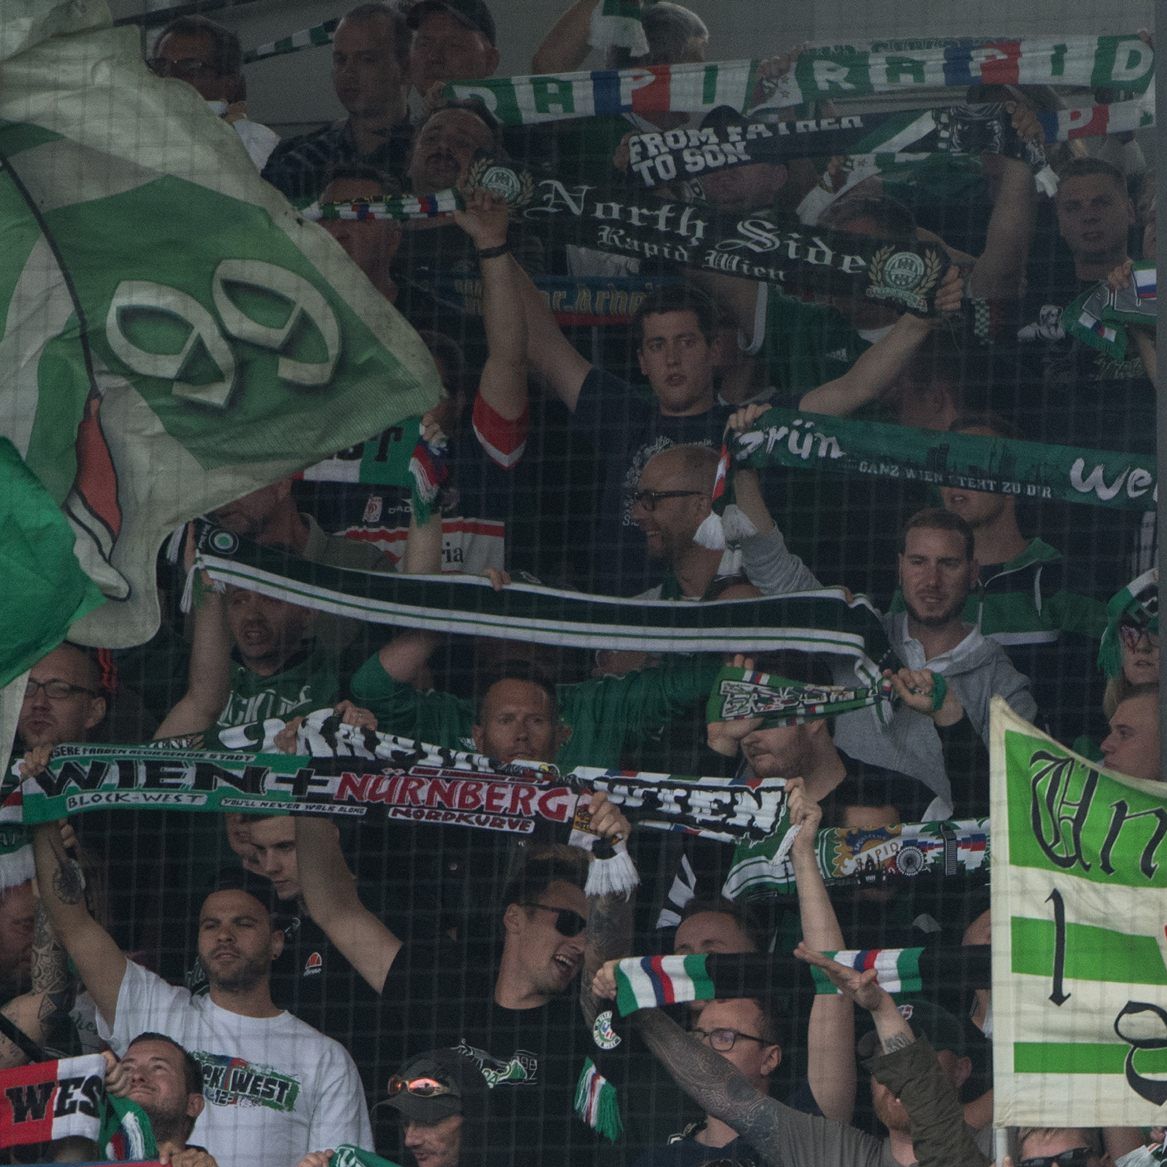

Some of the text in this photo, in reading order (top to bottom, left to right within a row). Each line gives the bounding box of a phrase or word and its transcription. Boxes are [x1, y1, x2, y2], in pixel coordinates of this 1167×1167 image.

[812, 40, 1152, 91] RAPID
[629, 126, 719, 163] FROM
[631, 142, 751, 188] TO SON
[524, 180, 867, 274] North Side
[597, 225, 787, 283] Rapid Wien
[34, 759, 270, 799] WIEN
[334, 768, 572, 823] NÜRNBERG
[67, 792, 204, 810] BLOCK-WEST
[391, 807, 532, 832] NORDKURVE
[232, 1067, 292, 1105] WEST
